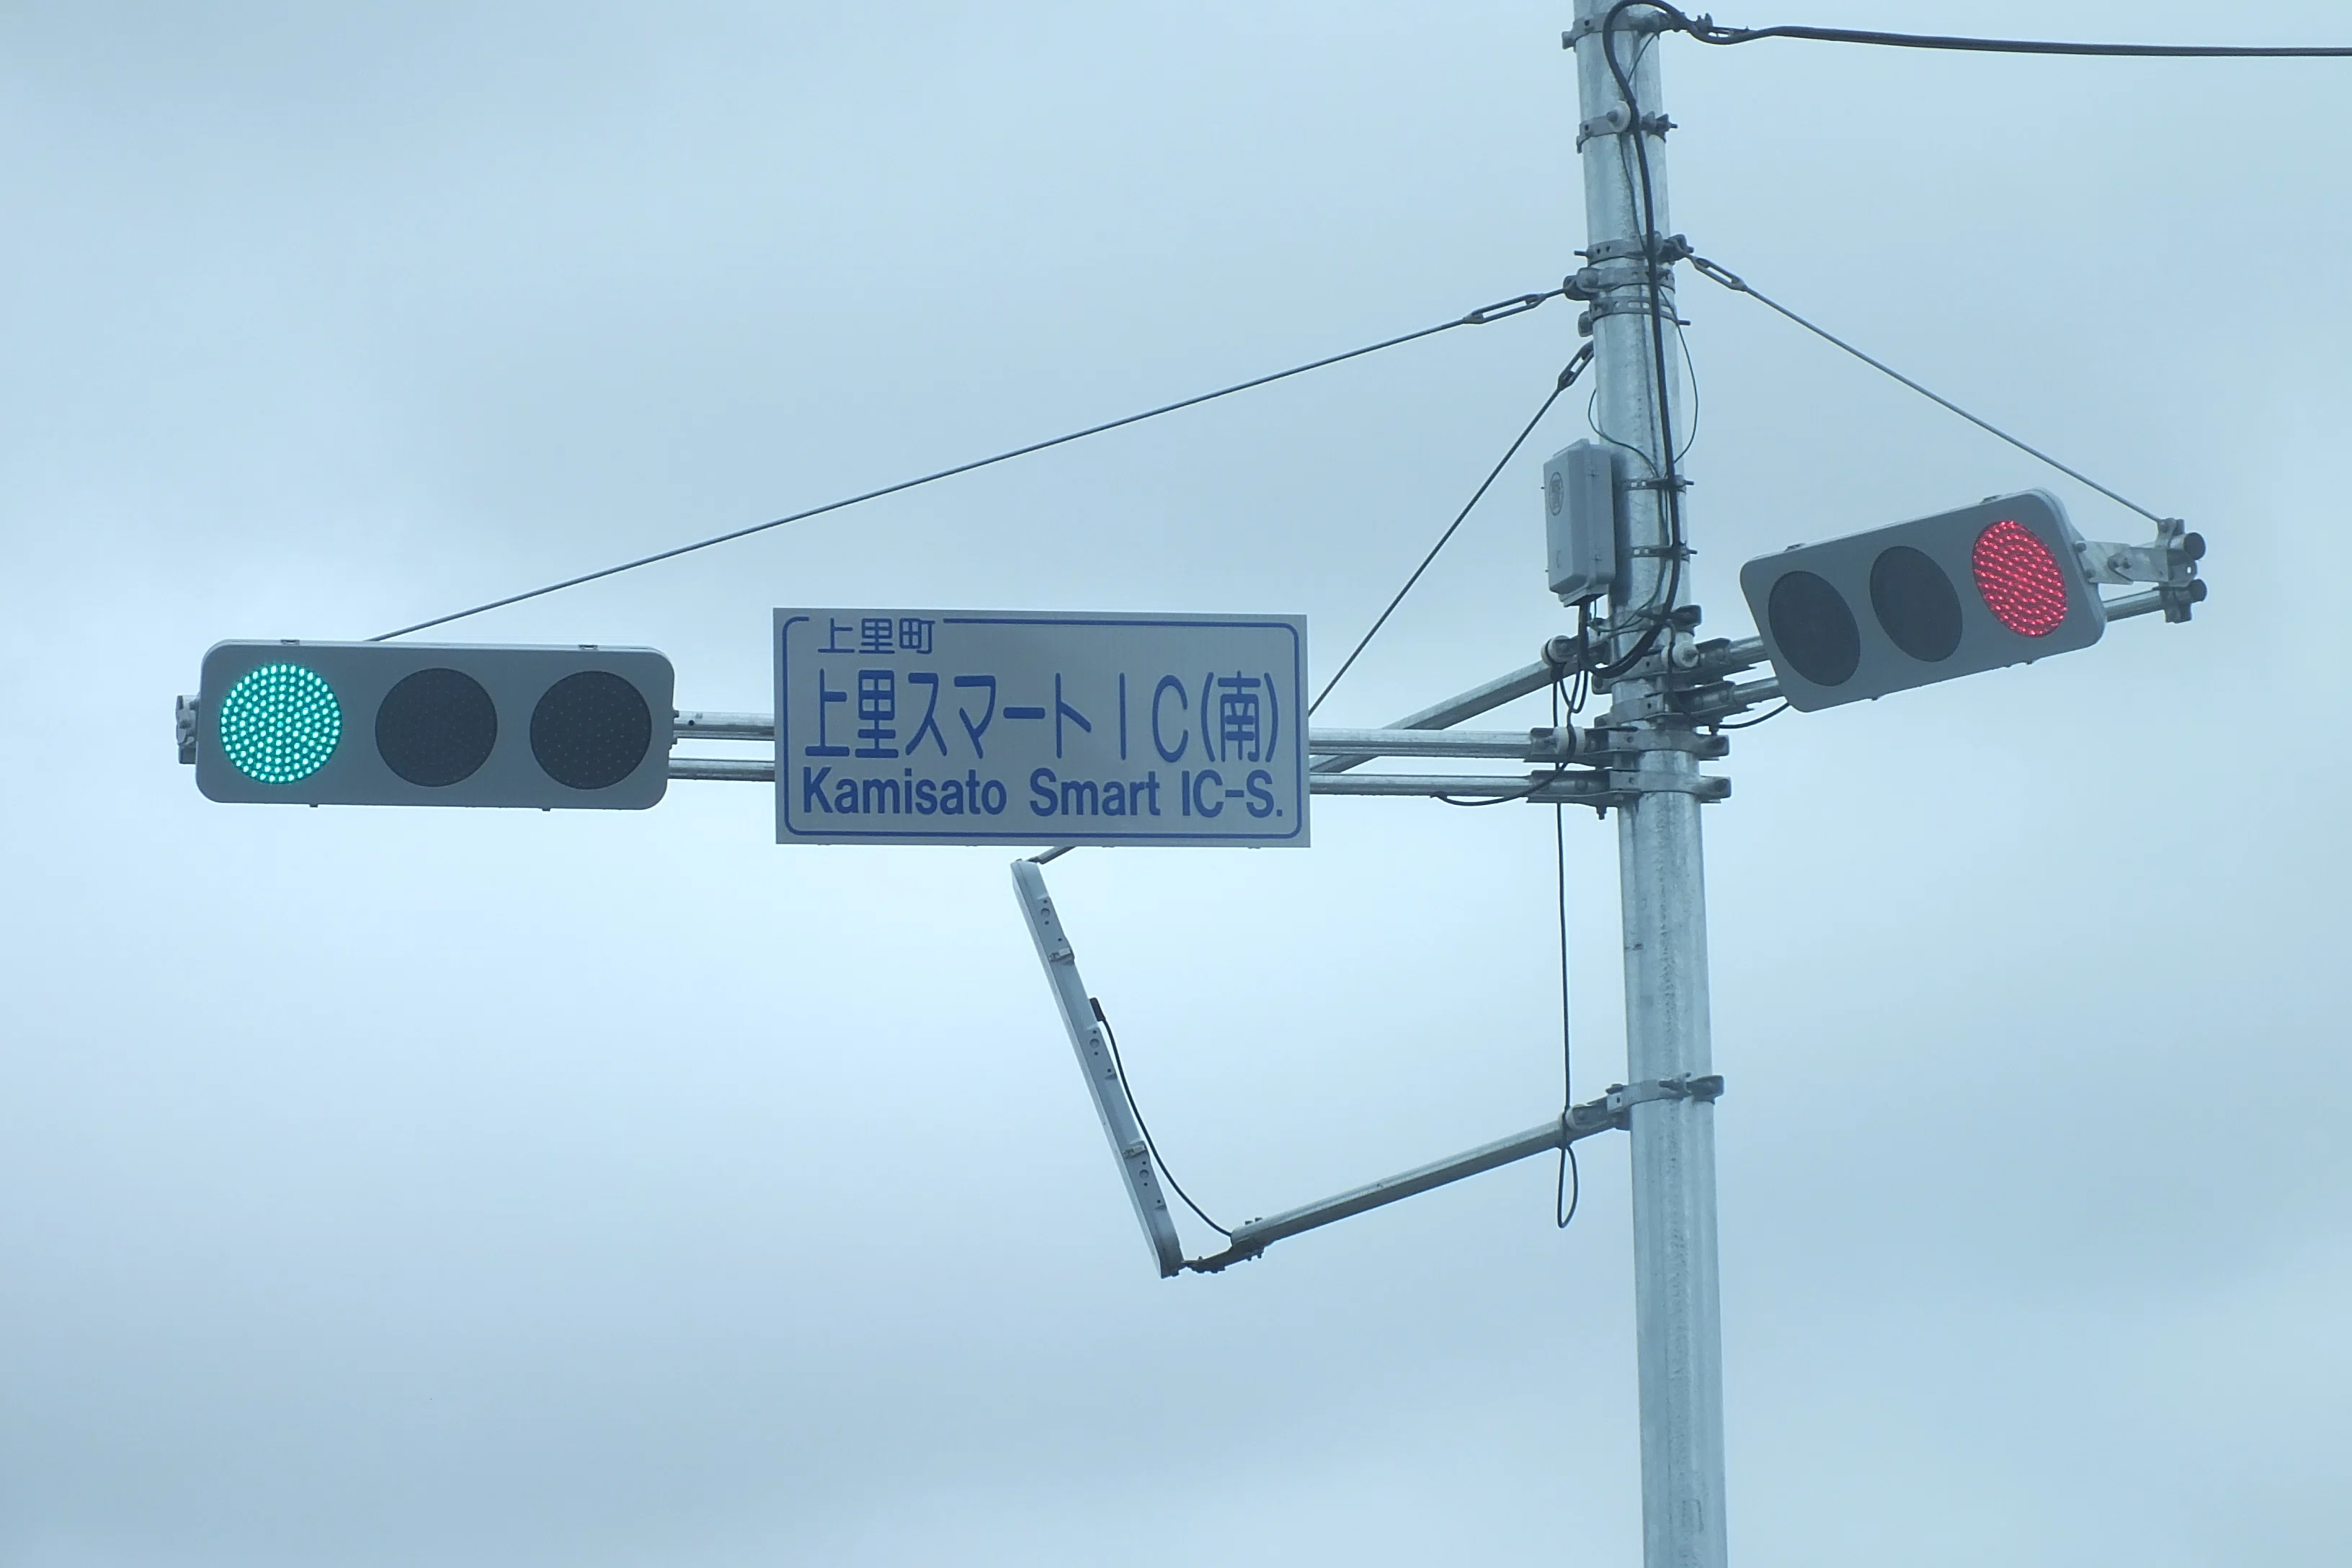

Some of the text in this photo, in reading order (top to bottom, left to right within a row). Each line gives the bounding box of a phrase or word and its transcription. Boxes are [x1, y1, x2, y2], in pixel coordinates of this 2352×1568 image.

[817, 618, 935, 654] 上里町
[803, 767, 1283, 818] Kamisato Smart IC-S.
